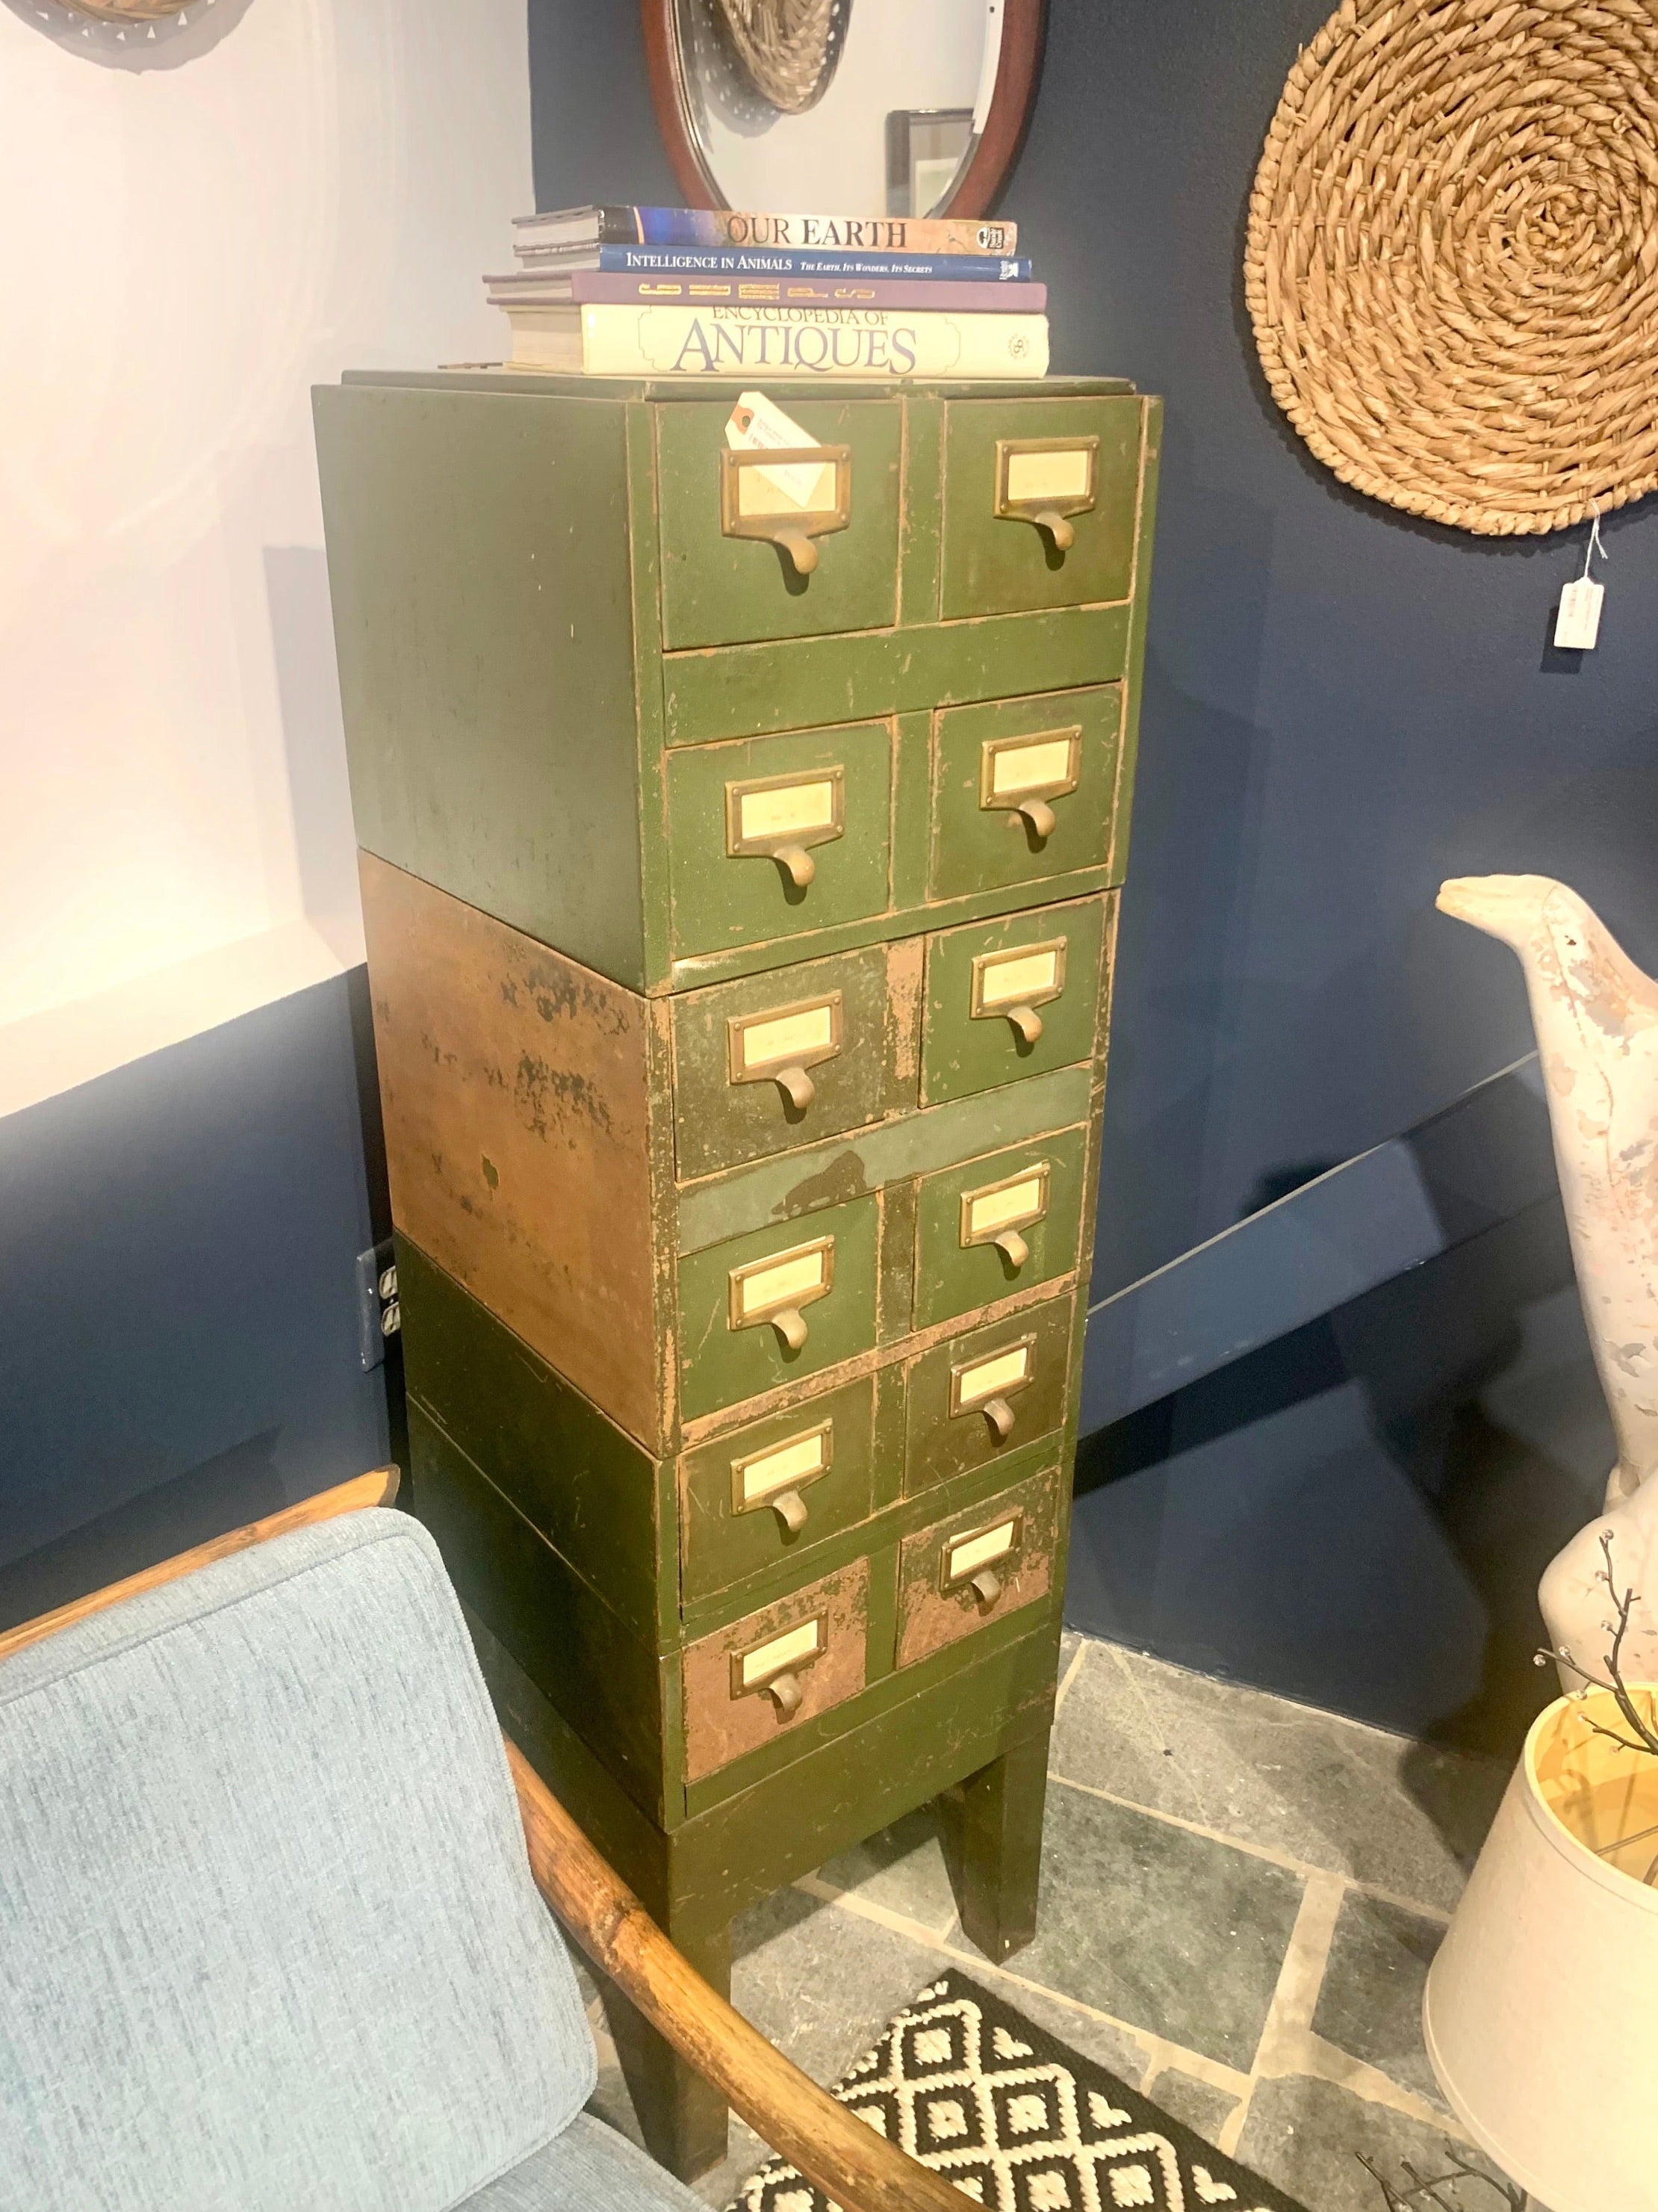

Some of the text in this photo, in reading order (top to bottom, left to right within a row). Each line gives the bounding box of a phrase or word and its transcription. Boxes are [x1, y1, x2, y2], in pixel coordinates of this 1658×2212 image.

[727, 216, 907, 247] OUR EARTH
[626, 252, 718, 268] INTELLIGENCE
[737, 255, 792, 270] ANIMALS
[903, 264, 932, 274] SECRETS
[712, 306, 889, 325] ENCYCLOPEDIA OF
[669, 317, 916, 375] ANTIQUES
